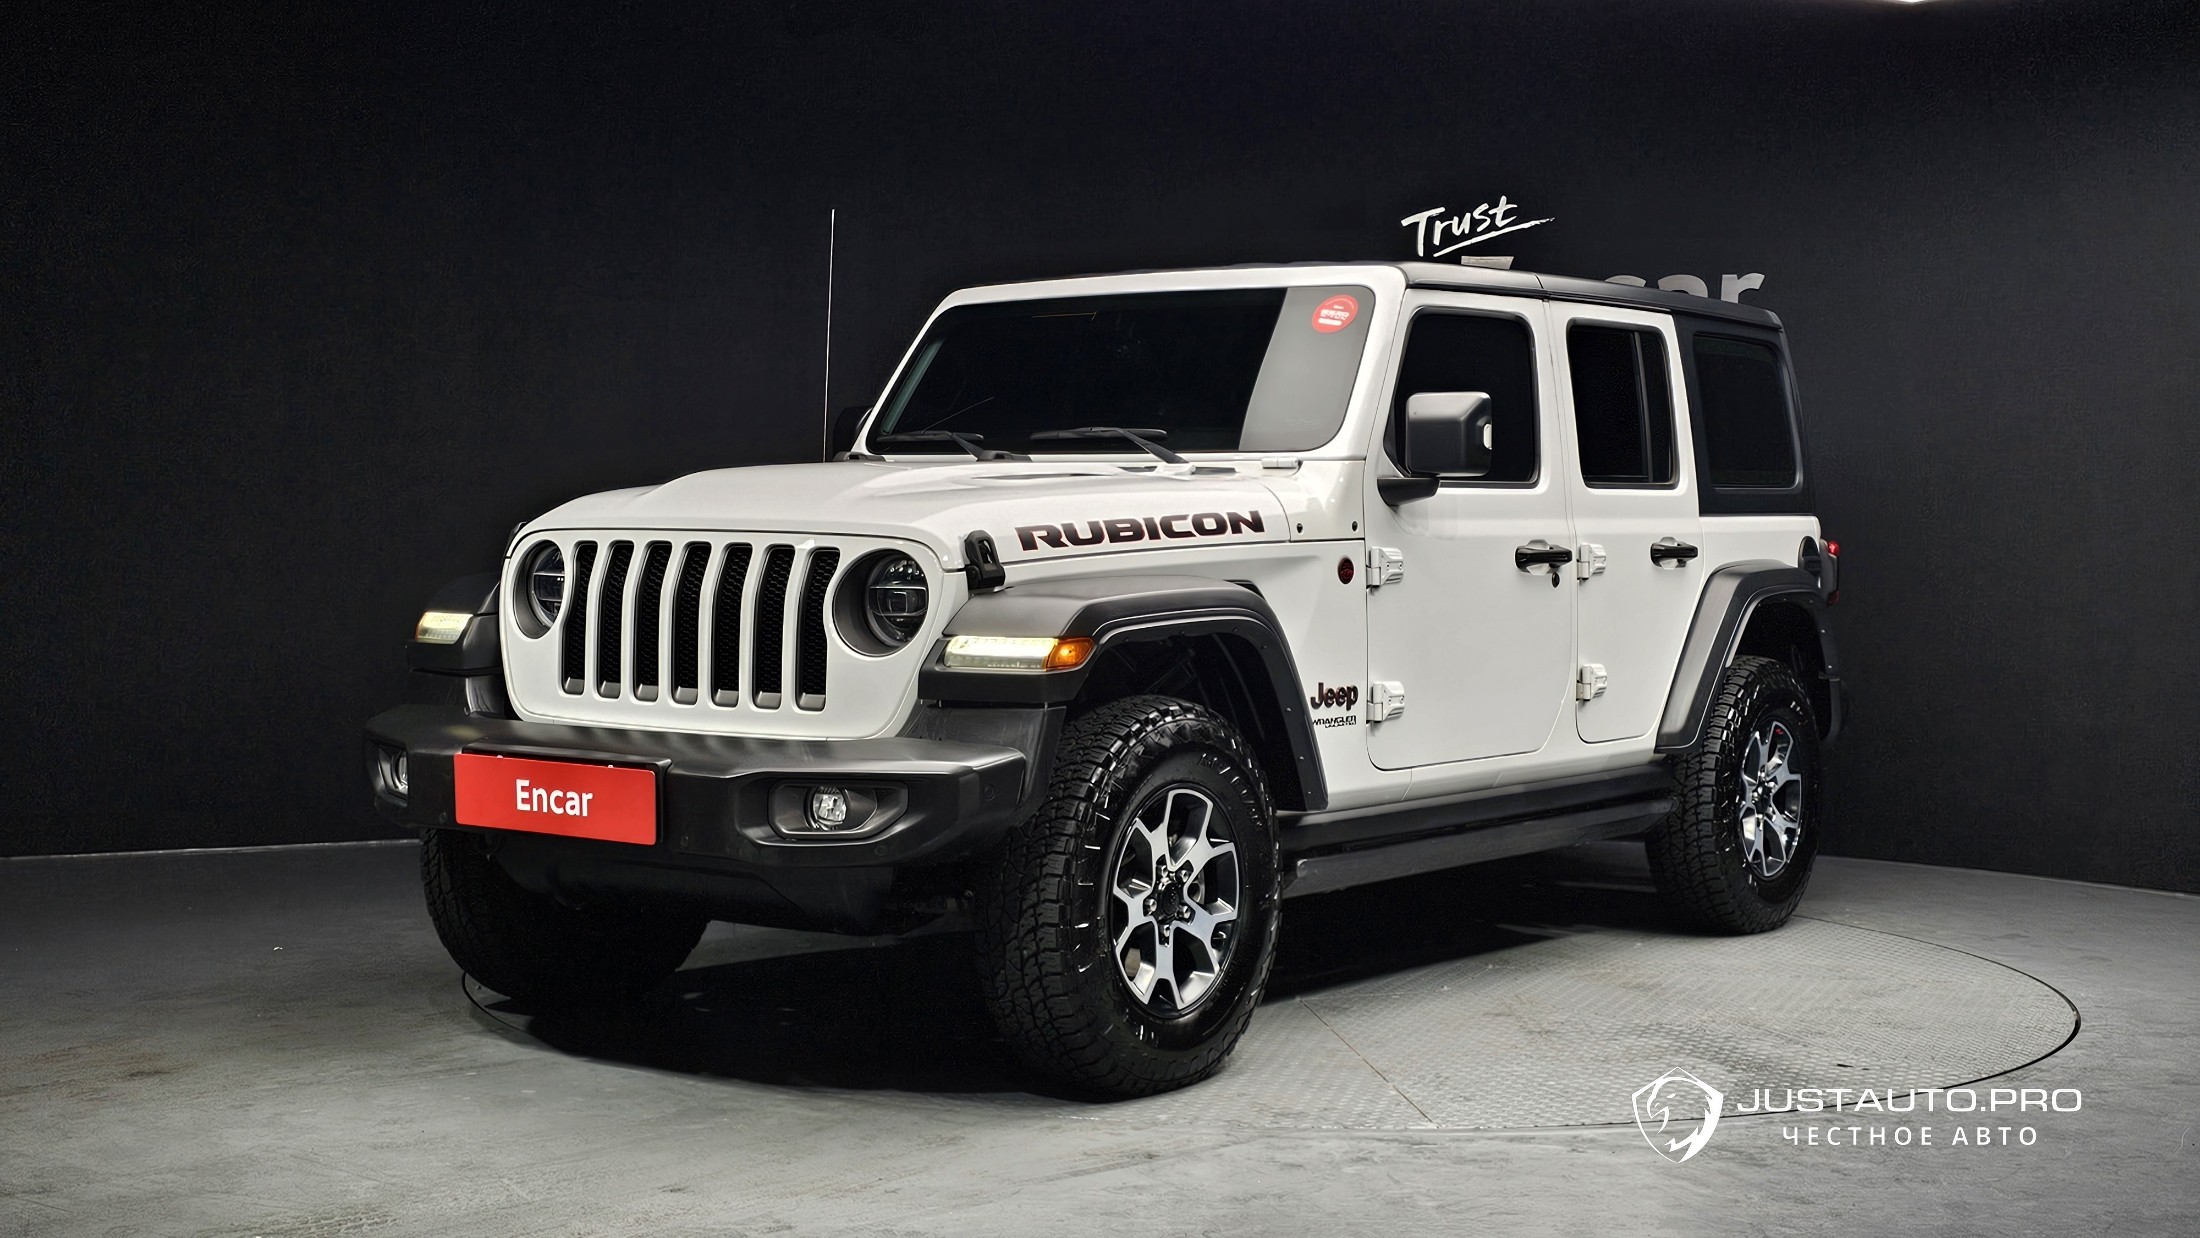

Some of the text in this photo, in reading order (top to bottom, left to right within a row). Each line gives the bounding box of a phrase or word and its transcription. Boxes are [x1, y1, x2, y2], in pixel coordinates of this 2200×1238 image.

[1400, 195, 1519, 258] Trust
[1014, 510, 1266, 552] RUBICON
[1310, 681, 1359, 711] Jeep
[515, 778, 594, 817] Encar
